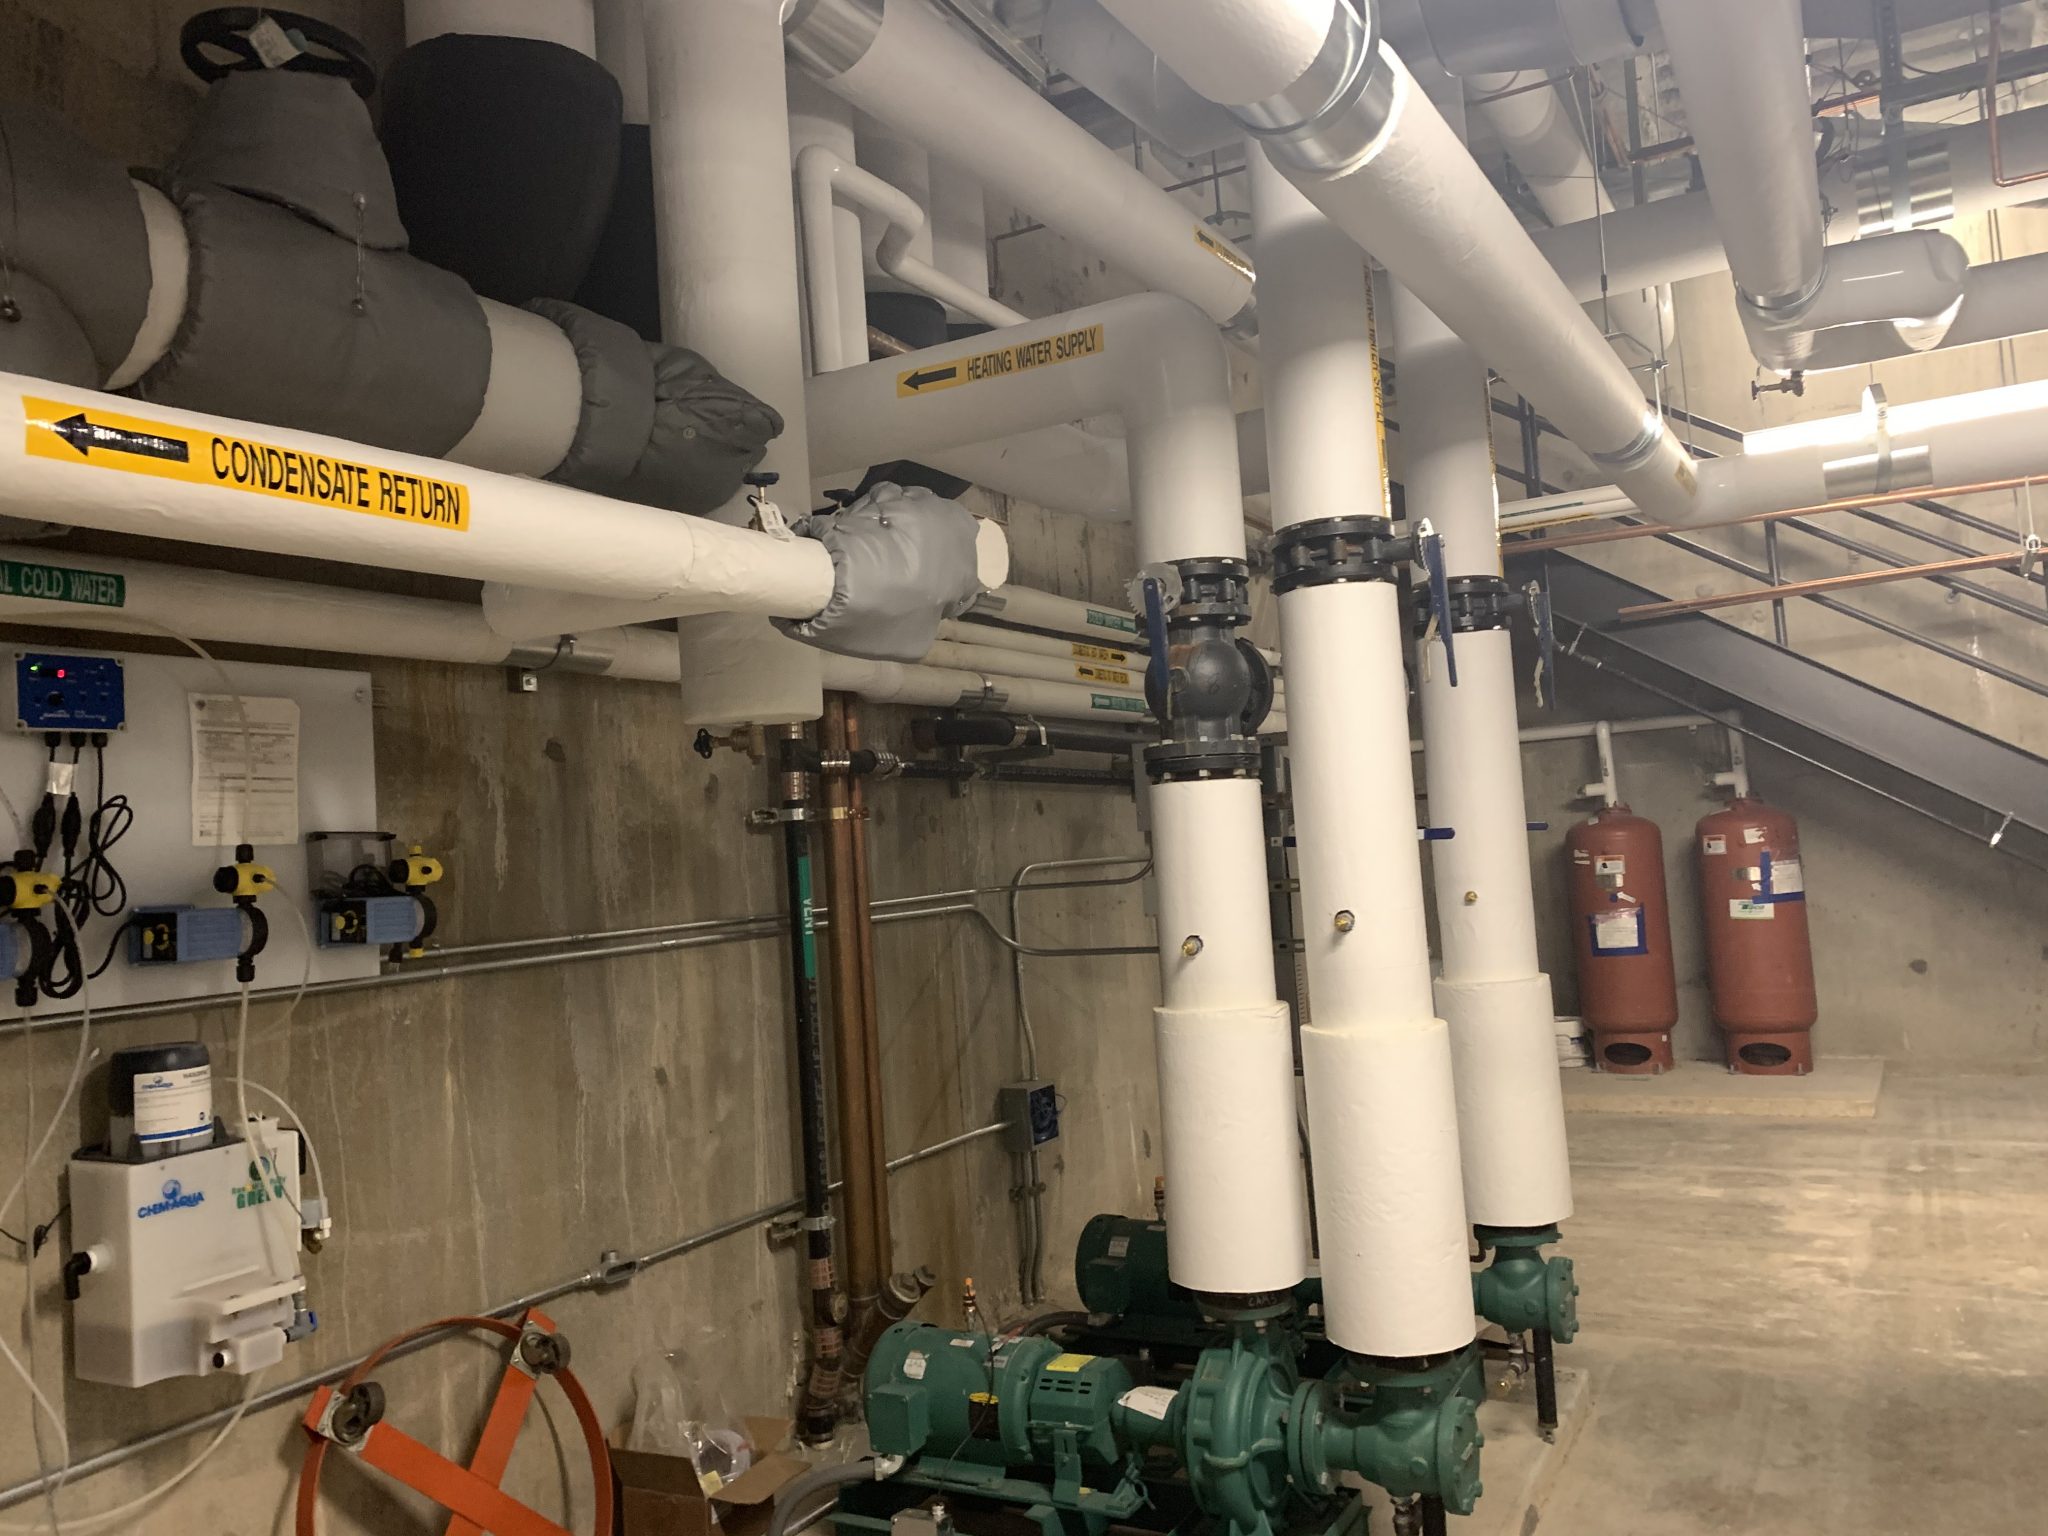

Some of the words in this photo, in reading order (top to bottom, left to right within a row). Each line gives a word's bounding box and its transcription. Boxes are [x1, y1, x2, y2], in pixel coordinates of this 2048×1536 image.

[967, 350, 1012, 381] HEATING
[1015, 340, 1053, 369] WATER
[1055, 327, 1097, 360] SUPPLY
[211, 437, 370, 508] CONDENSATE
[378, 471, 461, 525] RETURN
[21, 566, 64, 598] COLD
[70, 572, 117, 605] WATER
[803, 898, 814, 935] VENT
